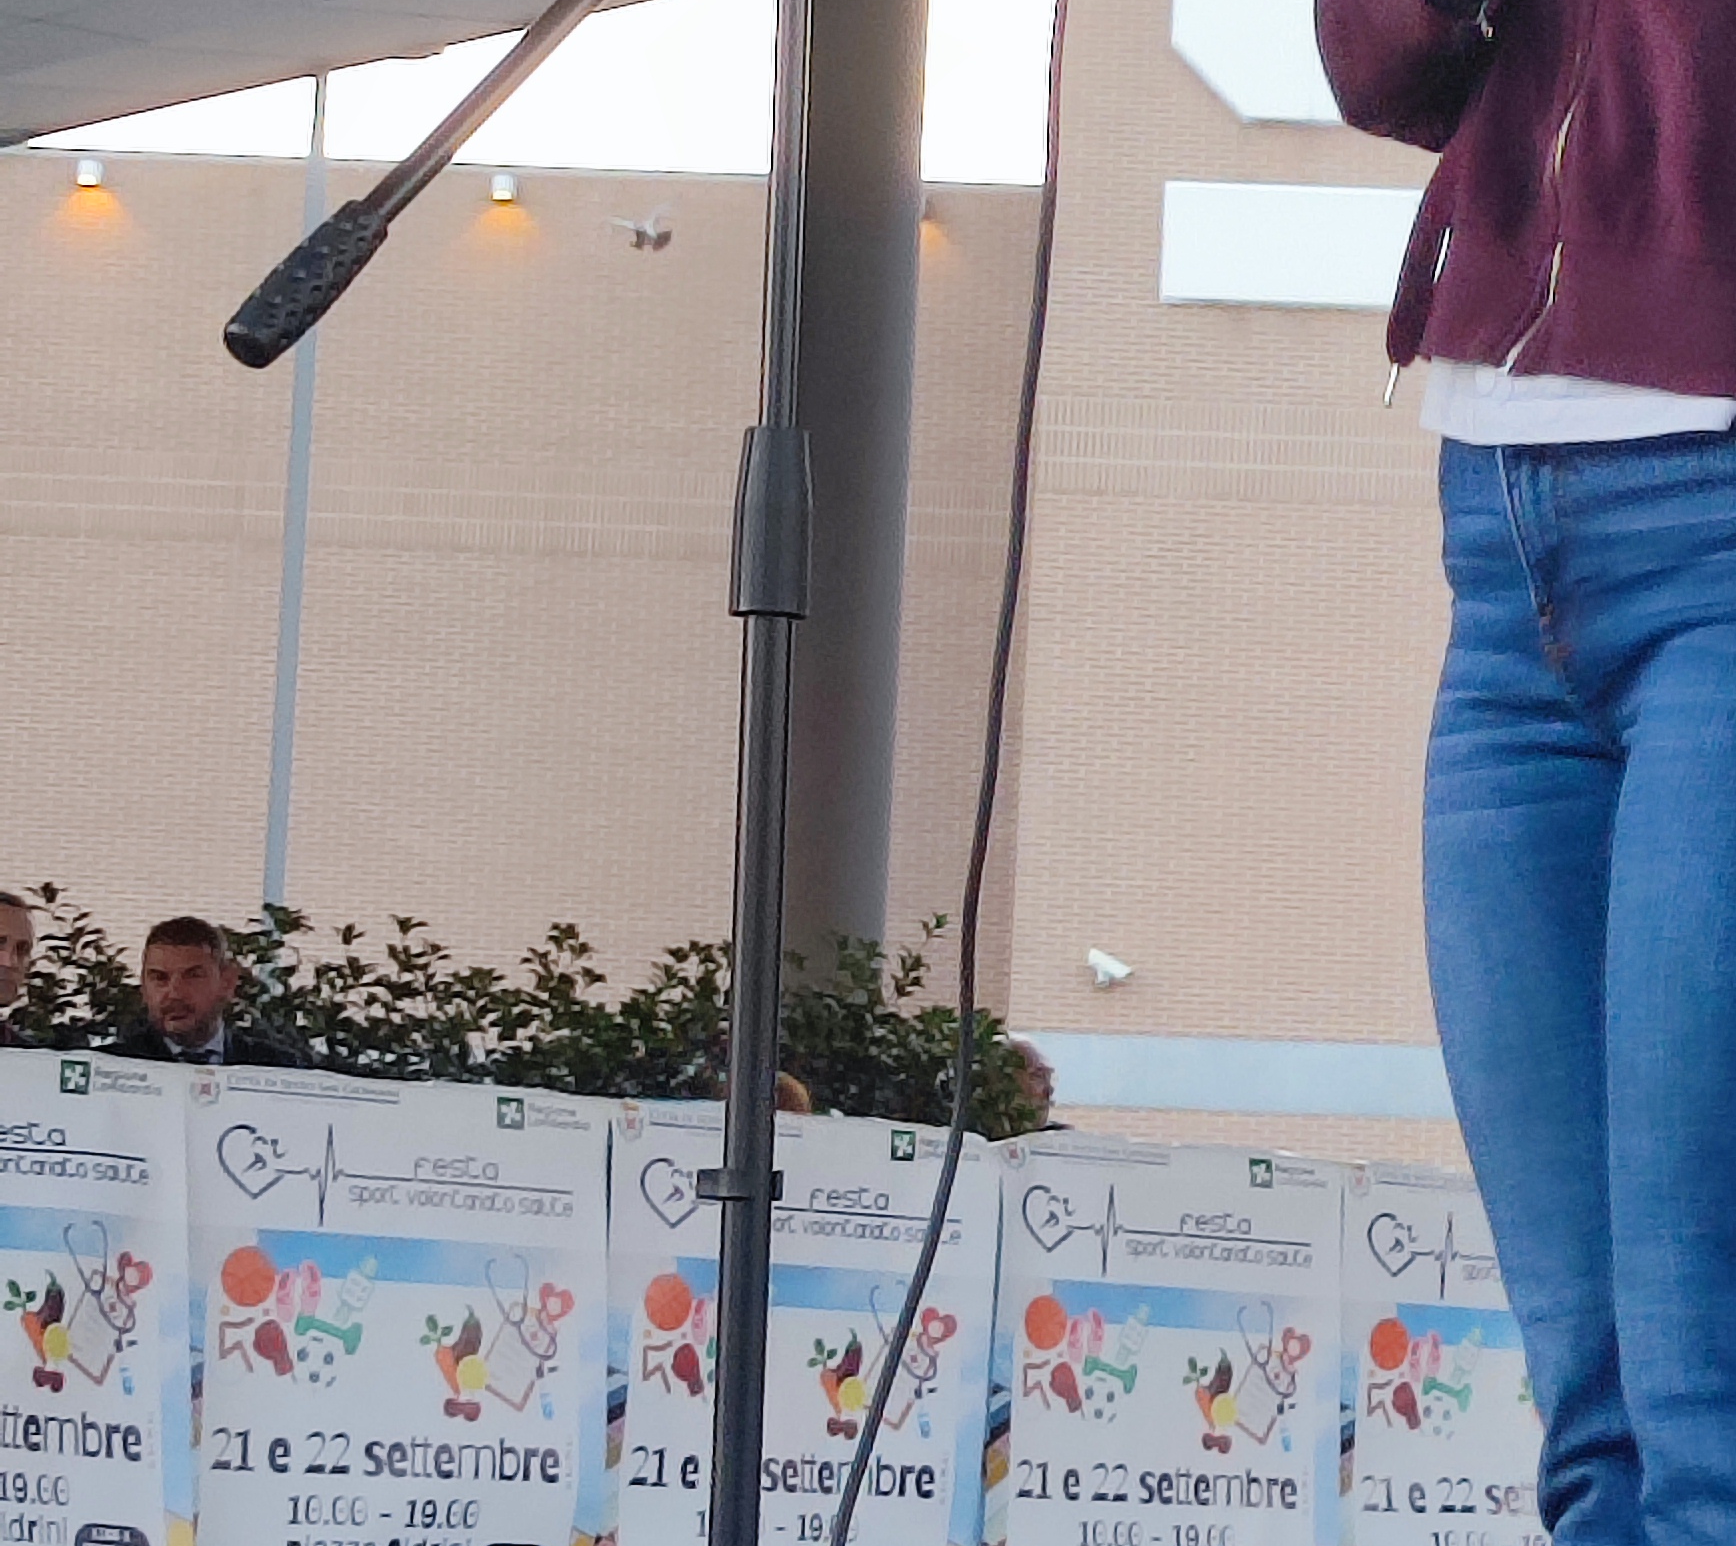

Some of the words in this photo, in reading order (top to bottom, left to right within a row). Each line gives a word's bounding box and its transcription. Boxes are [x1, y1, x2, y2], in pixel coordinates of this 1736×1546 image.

[210, 1427, 255, 1473] 21
[268, 1435, 292, 1473] e
[303, 1431, 352, 1475] 22
[363, 1436, 561, 1484] settembre
[628, 1446, 668, 1487] 21
[680, 1454, 700, 1489] e
[1015, 1459, 1053, 1500] 21
[1063, 1467, 1081, 1501] e
[1091, 1462, 1129, 1503] 22
[1139, 1466, 1297, 1509] settembre
[1361, 1475, 1399, 1512] 21
[1408, 1482, 1427, 1513] e
[1436, 1477, 1477, 1514] 22
